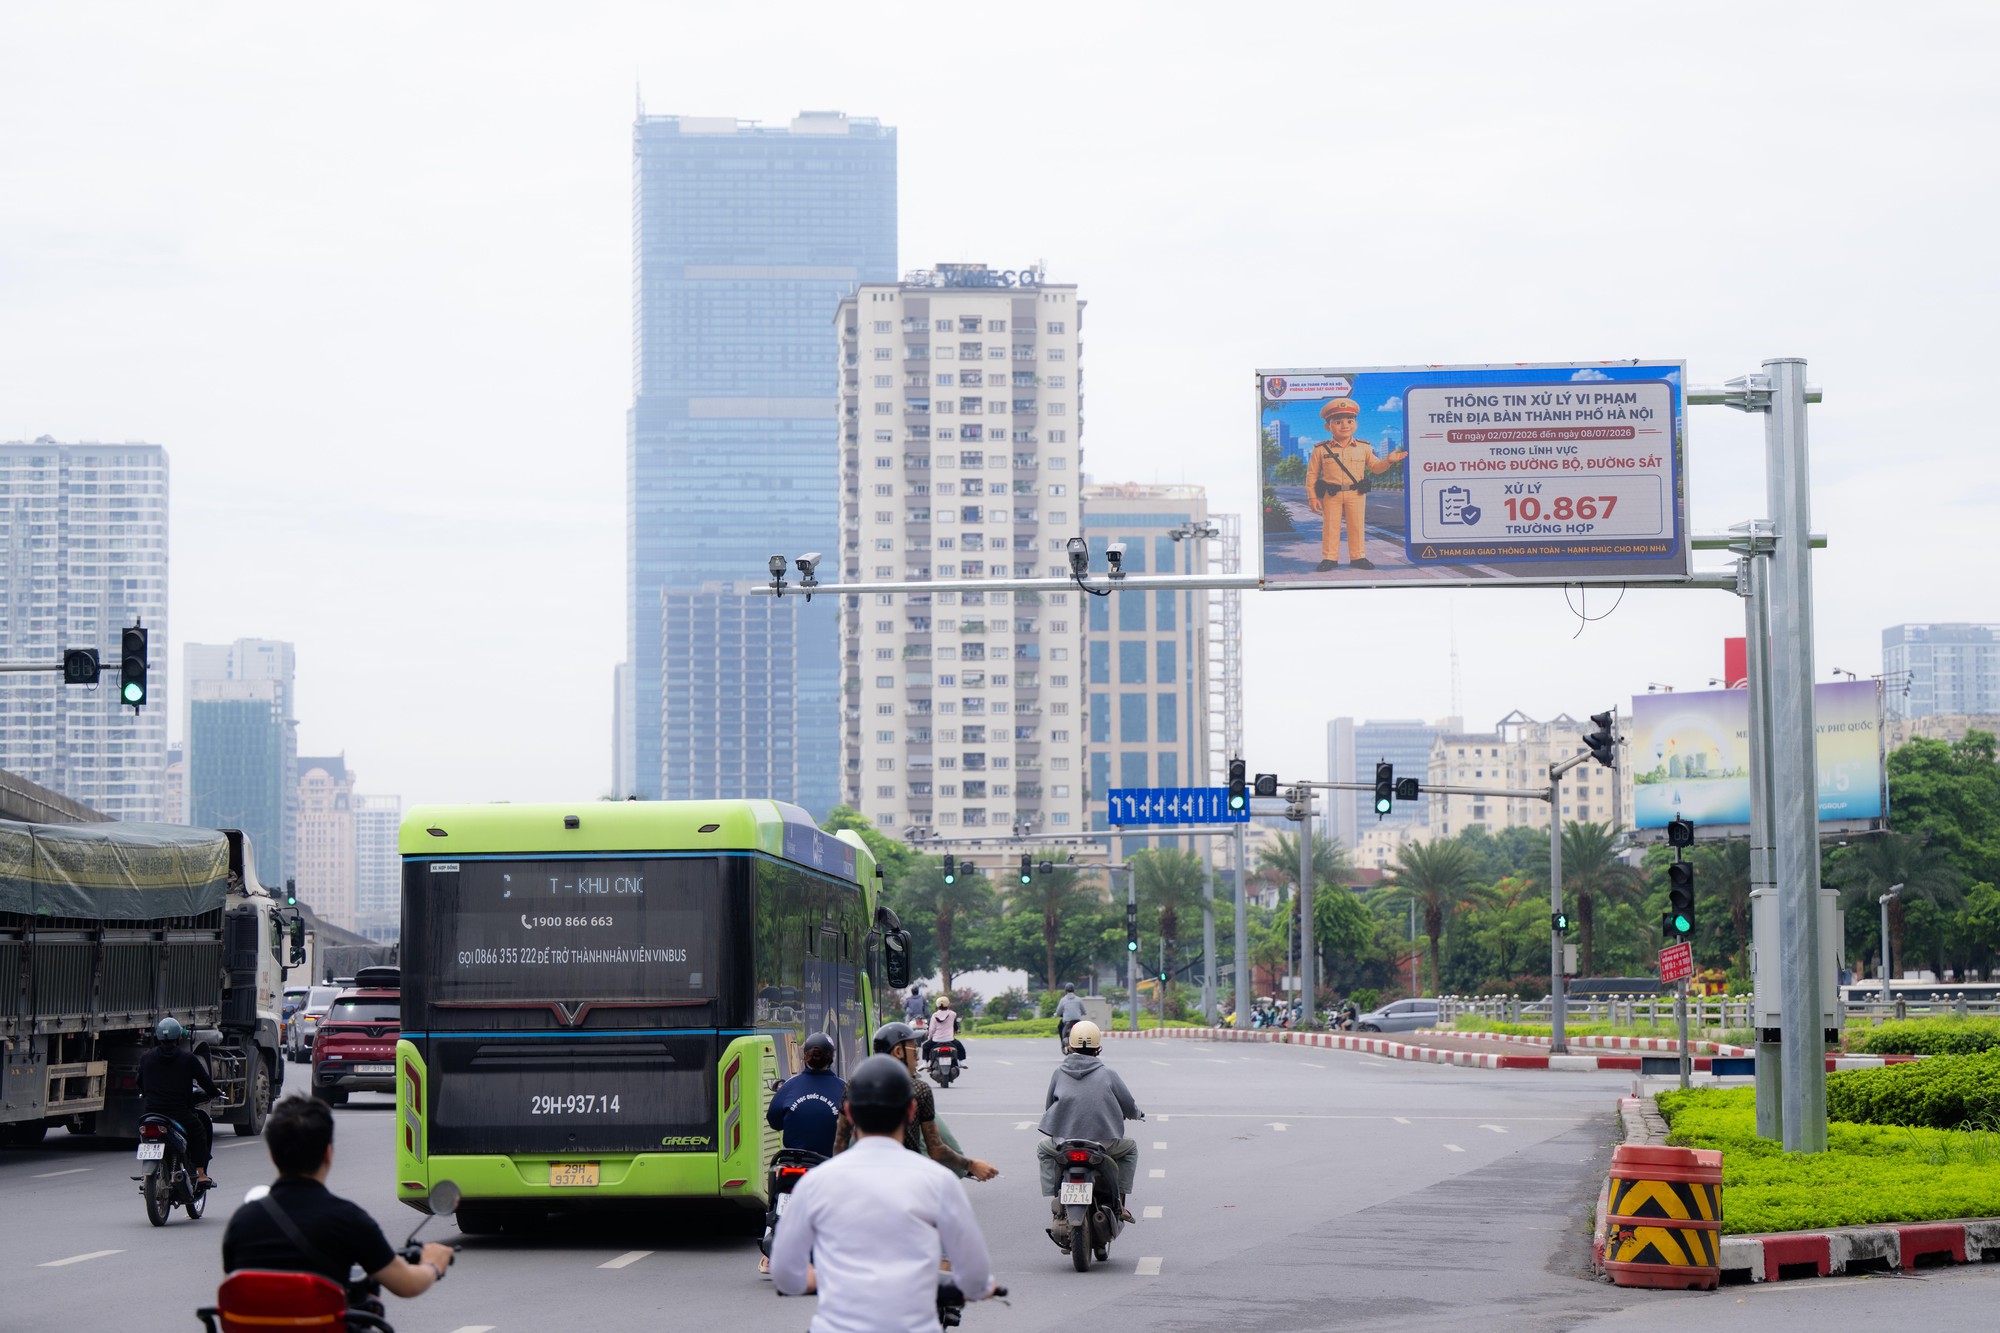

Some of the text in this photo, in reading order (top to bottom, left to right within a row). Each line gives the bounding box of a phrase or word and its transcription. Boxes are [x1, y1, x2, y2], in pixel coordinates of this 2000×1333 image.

[943, 270, 1037, 288] VIMECO
[1445, 391, 1636, 407] THÔNG TIN XỬ LÝ VI PHẠM
[1428, 406, 1654, 424] TRÊN ĐỊA BÀN THÀNH PHỐ HÀ NỘI
[1452, 428, 1632, 441] Từ ngày 02/07/2026 đến ngày 08/07/2026
[1490, 445, 1578, 456] TRONG LĨNH VỰC
[1423, 454, 1662, 472] GIAO THÔNG ĐƯỜNG BỘ, ĐƯỜNG SẮT
[1504, 482, 1542, 494] XỬ LÝ
[1504, 496, 1618, 520] 10.867
[1506, 522, 1594, 534] TRƯỜNG HỢP
[1568, 547, 1590, 555] HẠNH
[1592, 544, 1612, 553] PHÚC
[1633, 546, 1648, 554] MỌI
[1650, 544, 1666, 552] NHÀ
[1848, 720, 1872, 732] QUỐC
[578, 878, 609, 894] KHU
[532, 916, 613, 926] 1900 866 663
[458, 952, 474, 968] GỌI
[475, 948, 498, 964] 0866
[499, 948, 518, 964] 355
[520, 948, 536, 963] 222
[538, 946, 550, 964] ĐỂ
[551, 946, 570, 964] TRỞ
[630, 946, 652, 962] VIÊN
[652, 949, 686, 962] VINBUS
[532, 1094, 620, 1114] 29H-937.14
[662, 1136, 711, 1146] GREEN
[565, 1164, 586, 1174] 29H
[556, 1175, 593, 1185] 937.14
[1066, 1184, 1088, 1193] 29-AK
[1063, 1194, 1090, 1203] 072.14
